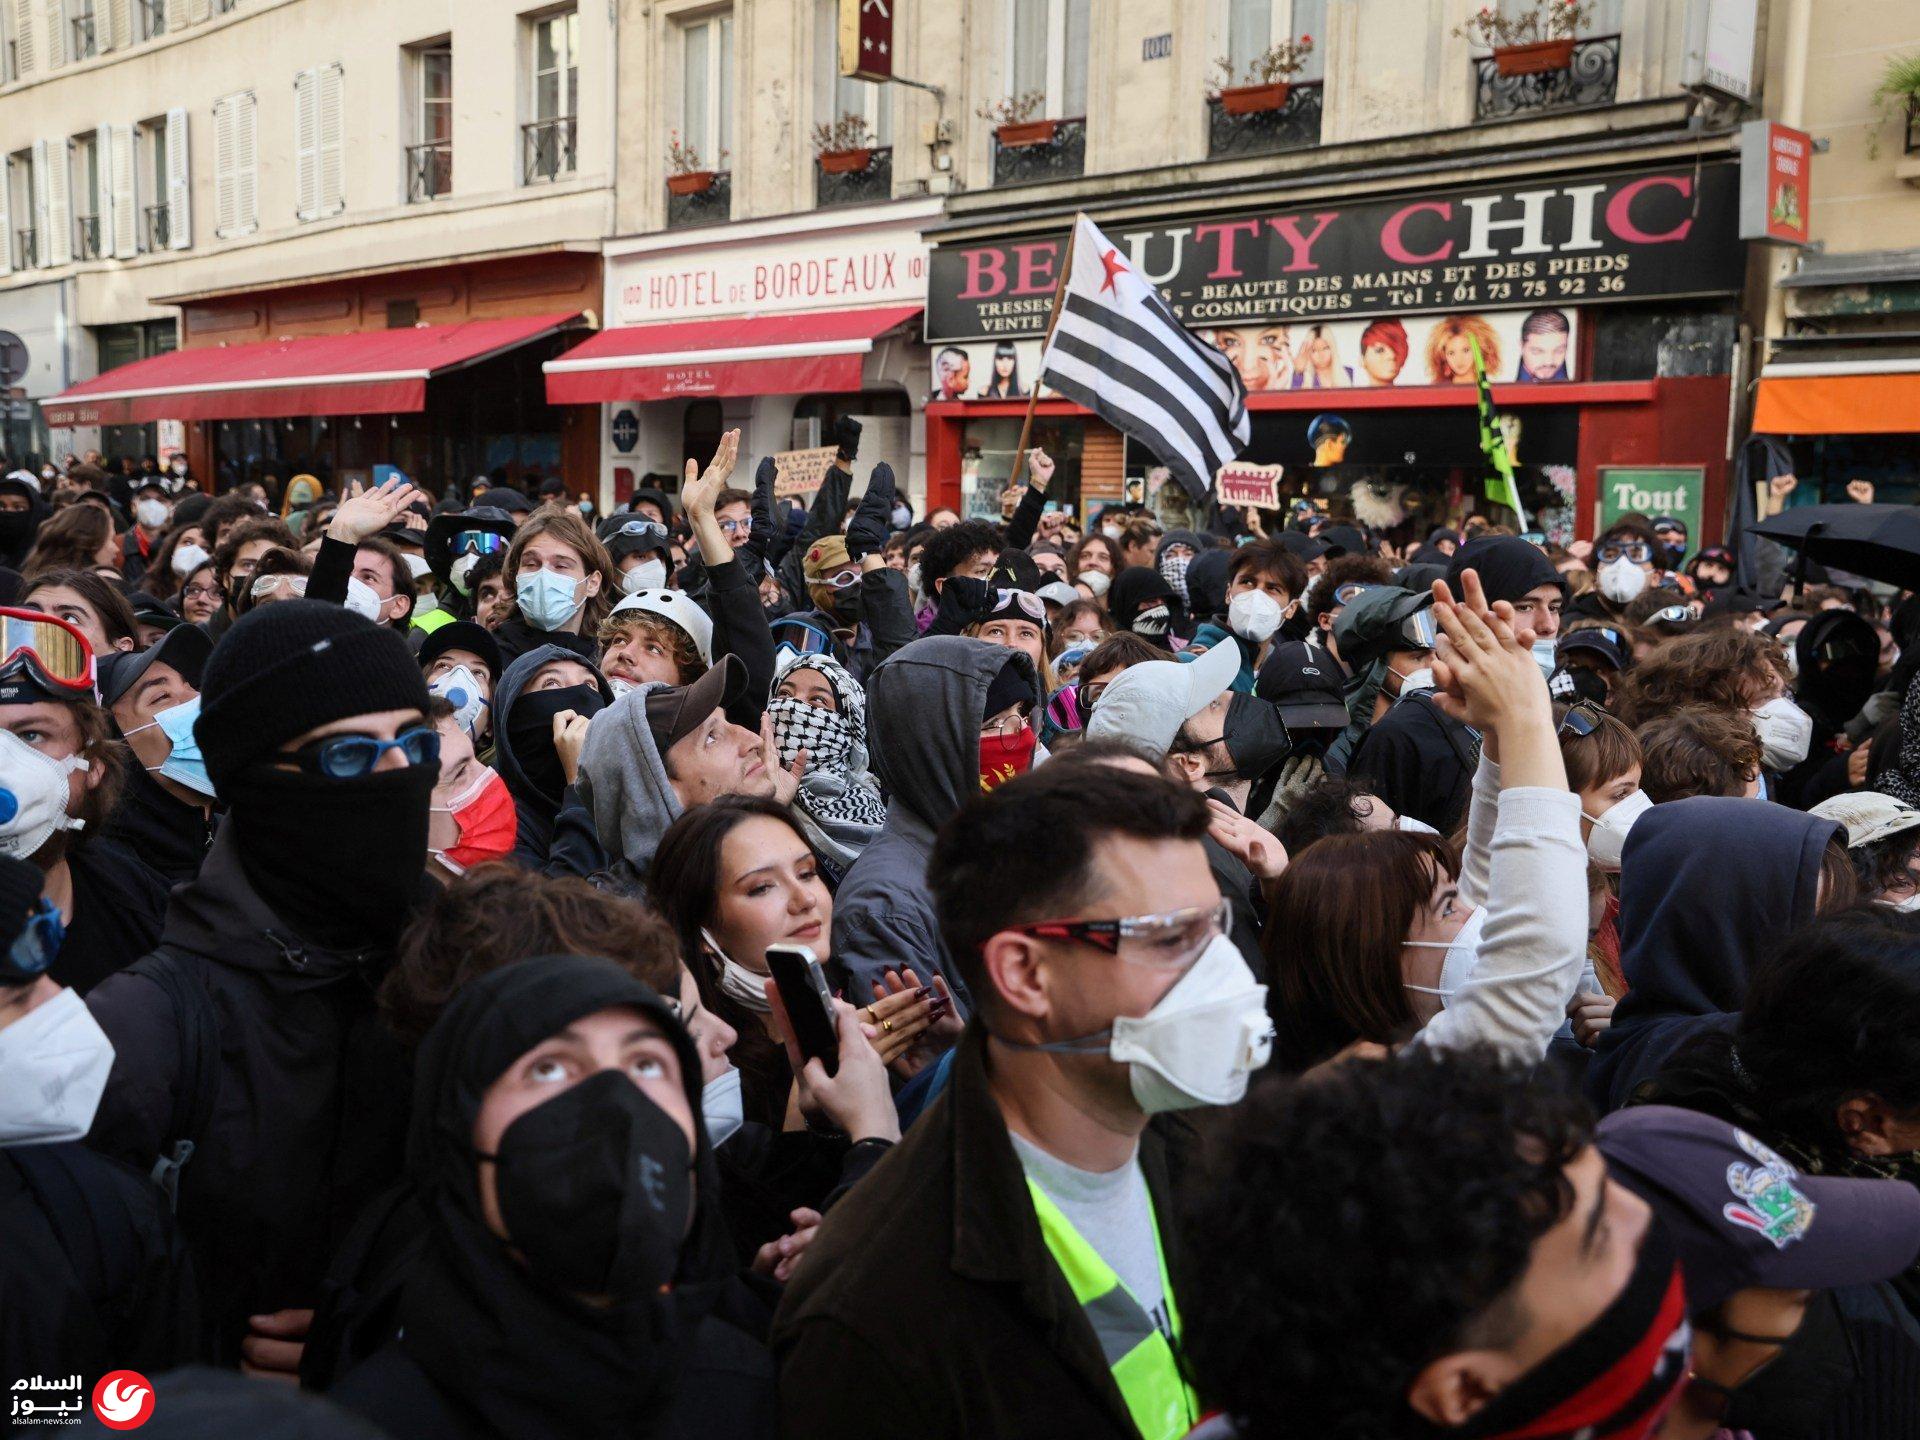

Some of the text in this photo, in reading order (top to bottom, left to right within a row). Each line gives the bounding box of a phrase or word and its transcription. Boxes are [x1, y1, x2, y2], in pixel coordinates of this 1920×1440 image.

[956, 176, 1693, 299] BEUTY CHIC
[650, 271, 722, 309] HOTEL
[729, 285, 747, 303] DE
[755, 252, 896, 300] BORDEAUX
[976, 298, 1052, 317] TRESSES
[1202, 279, 1289, 300] BEAUTE
[1298, 275, 1343, 293] DES
[1352, 269, 1433, 289] MAINS
[1443, 265, 1477, 282] ET
[1486, 260, 1537, 279] DES
[1549, 253, 1630, 275] PIEDS
[981, 315, 1043, 332] VENTE
[1191, 293, 1353, 318] COSMETIQUES
[1454, 283, 1477, 301] 01
[1487, 282, 1511, 299] 73
[1521, 280, 1548, 297] 75
[1559, 277, 1586, 294] 92
[1598, 274, 1627, 293] 36
[1613, 483, 1688, 511] Tout
